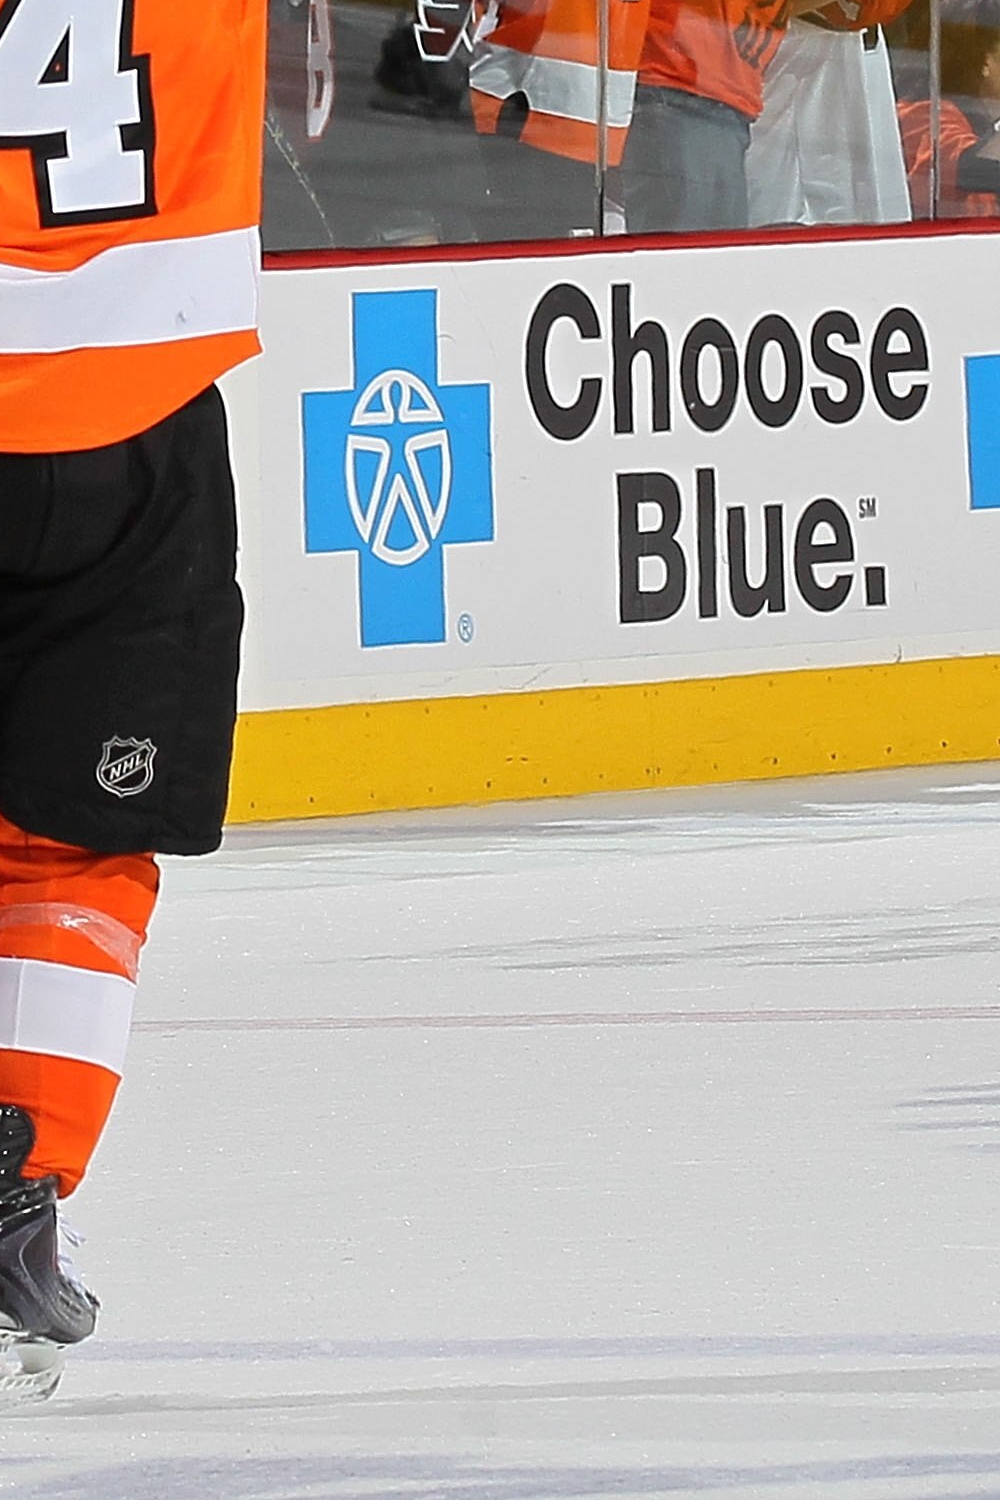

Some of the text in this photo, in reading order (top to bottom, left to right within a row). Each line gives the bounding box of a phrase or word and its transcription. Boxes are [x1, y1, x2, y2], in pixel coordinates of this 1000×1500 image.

[526, 284, 930, 441] Choose
[616, 466, 888, 624] Blue.
[109, 753, 144, 781] NHL
